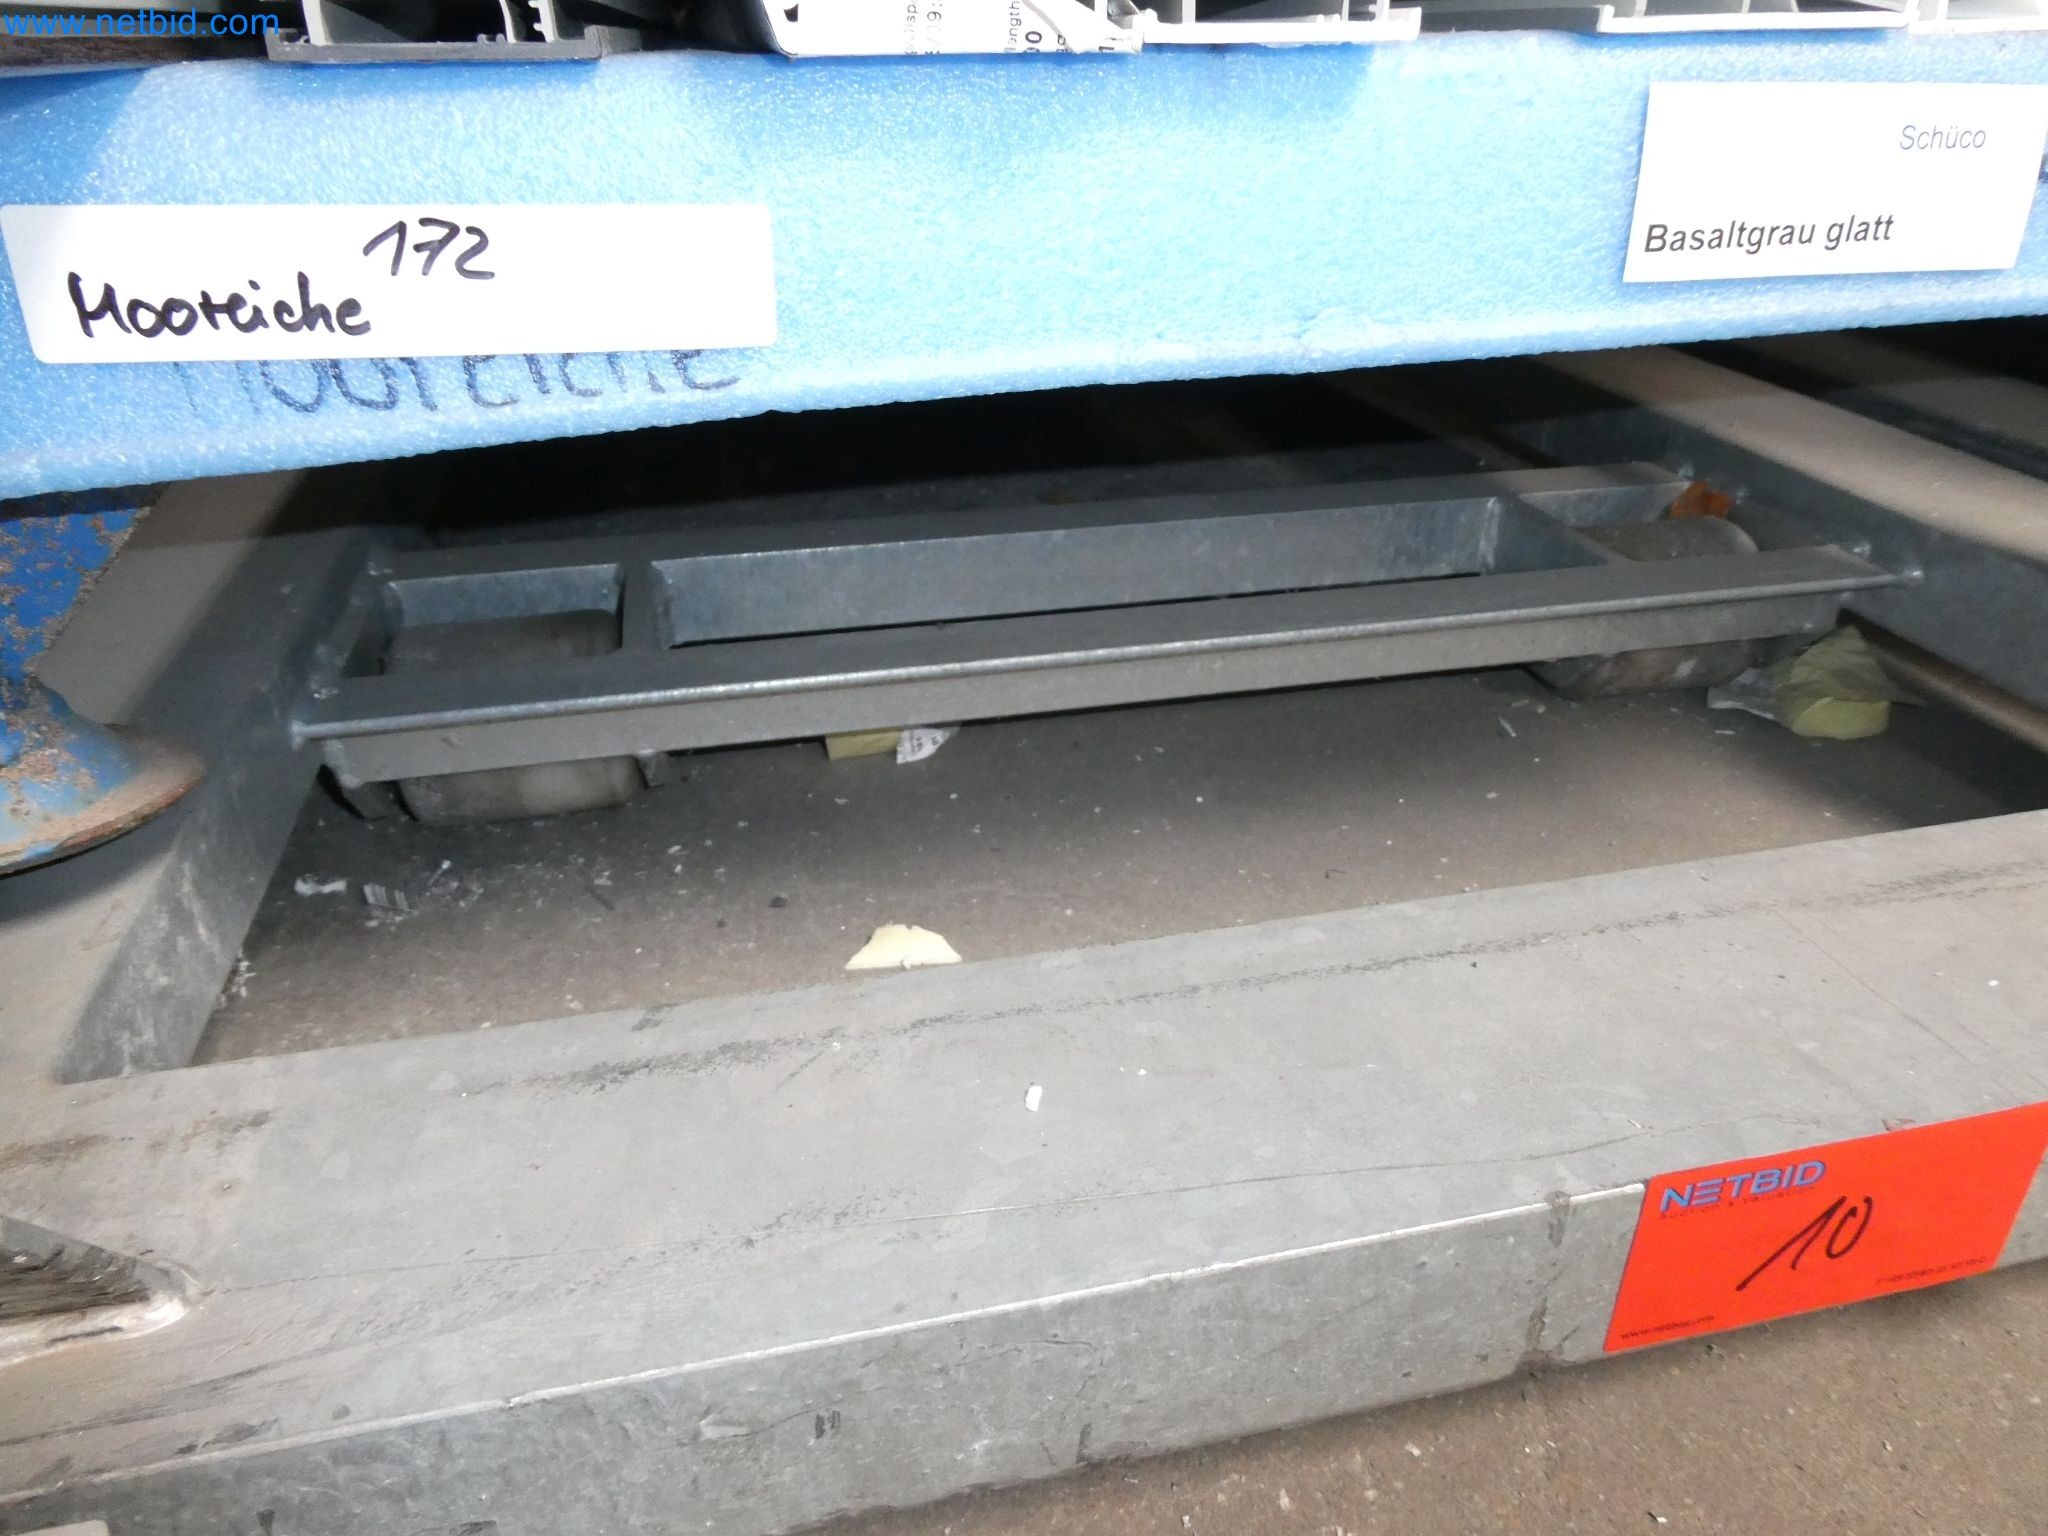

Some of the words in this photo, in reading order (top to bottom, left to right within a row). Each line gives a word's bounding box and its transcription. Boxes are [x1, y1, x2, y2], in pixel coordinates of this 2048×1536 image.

[1900, 125, 1986, 150] Schüco
[363, 217, 496, 280] 172
[1644, 220, 1815, 254] Basaltgrau
[1824, 214, 1895, 251] glatt
[67, 271, 371, 338] Mooreiche
[1659, 1160, 1827, 1213] NETBID
[1735, 1195, 1874, 1292] 10
